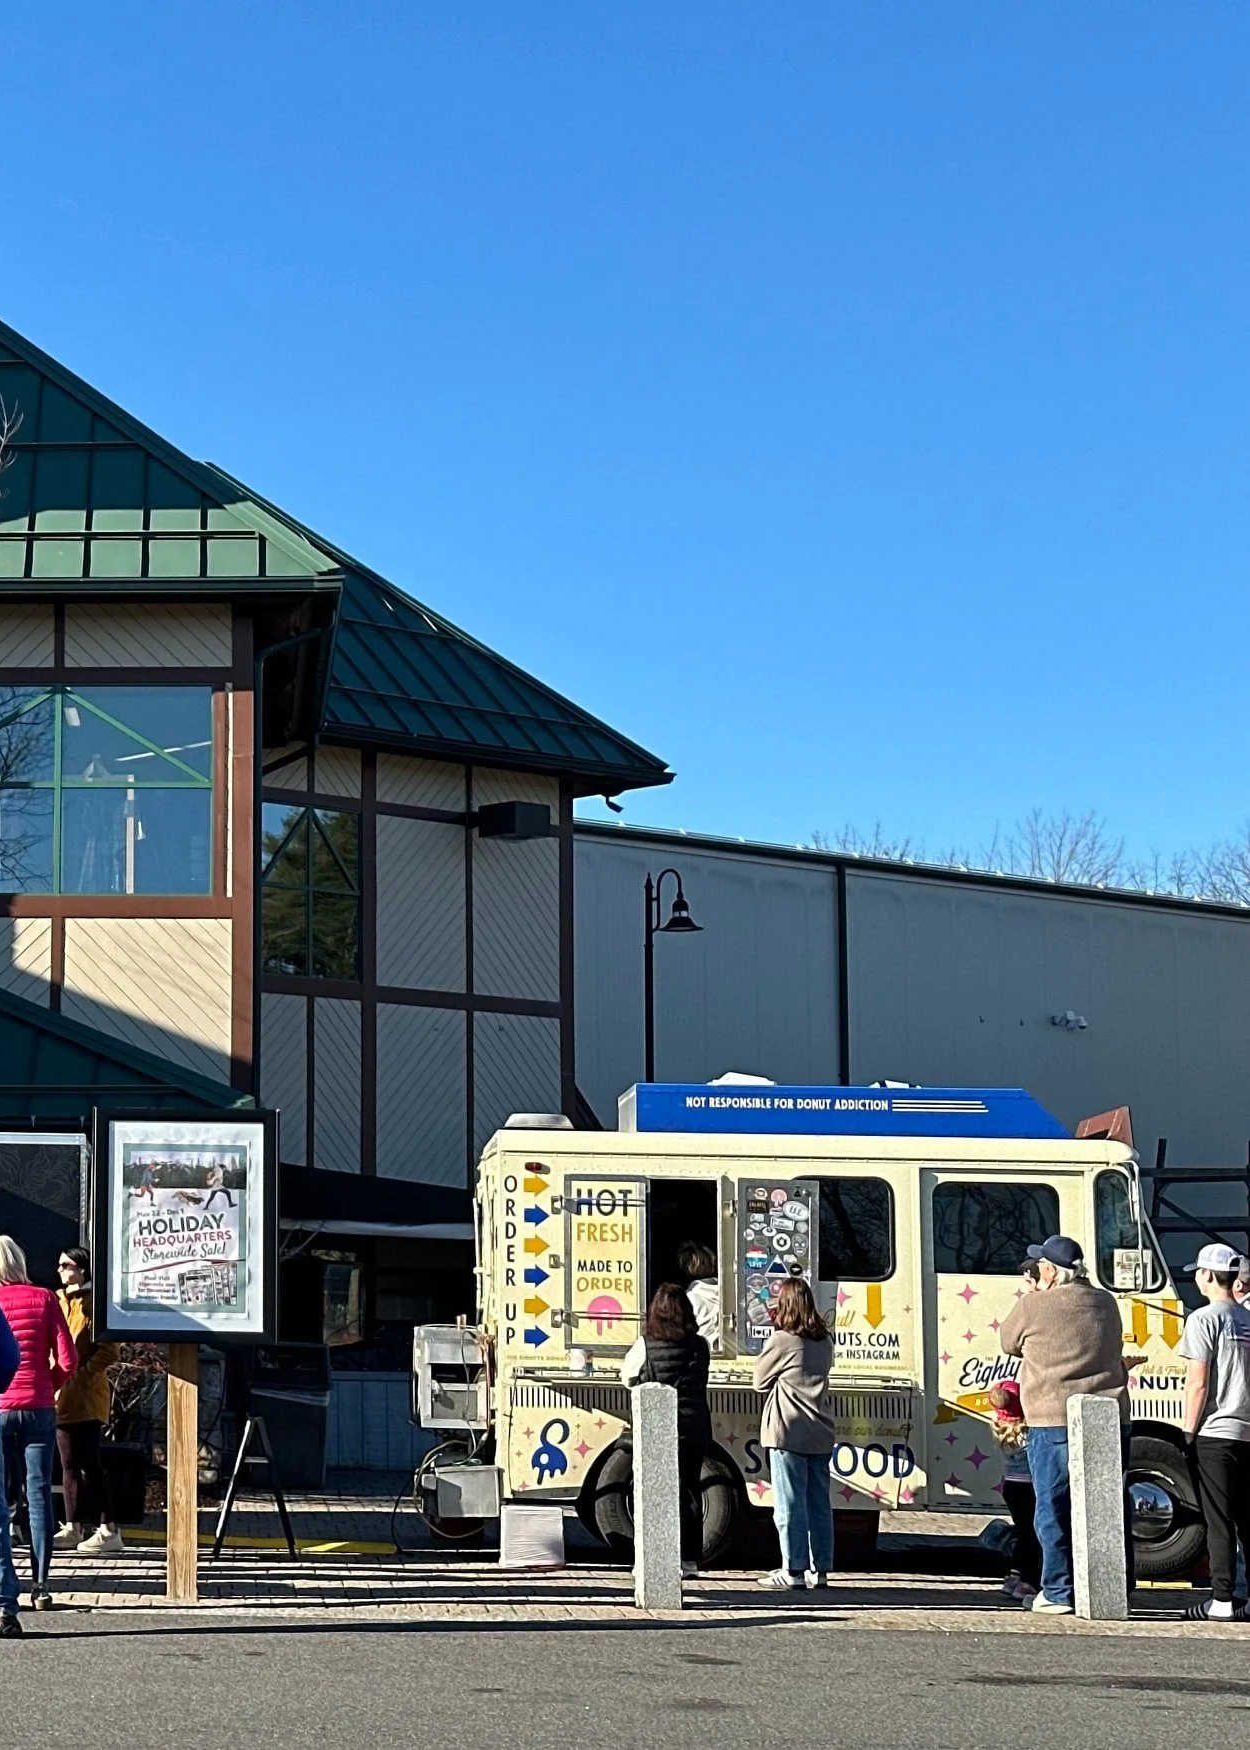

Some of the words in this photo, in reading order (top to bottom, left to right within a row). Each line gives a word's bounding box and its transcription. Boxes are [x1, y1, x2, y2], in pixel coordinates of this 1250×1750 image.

[686, 1097, 706, 1108] NOT
[709, 1097, 772, 1109] RESPONSIBLE
[774, 1098, 794, 1110] FOR
[797, 1099, 831, 1110] DONUT
[834, 1099, 889, 1111] ADDICTION
[576, 1188, 633, 1216] HOT
[138, 1213, 225, 1236] HOLIDAY
[504, 1175, 518, 1286] ORDER
[576, 1222, 633, 1243] FRESH
[133, 1230, 233, 1248] HEADQUARTERS
[142, 1244, 199, 1263] Storewide
[199, 1241, 226, 1259] Sale!
[577, 1260, 612, 1273] MADE
[616, 1260, 633, 1273] TO
[576, 1277, 634, 1295] ORDER
[505, 1303, 517, 1345] UP
[846, 1349, 901, 1361] INSTAGRAM
[958, 1353, 1022, 1391] Eighty
[1156, 1365, 1163, 1375] &
[744, 1438, 771, 1474] S
[832, 1441, 916, 1478] OOD
